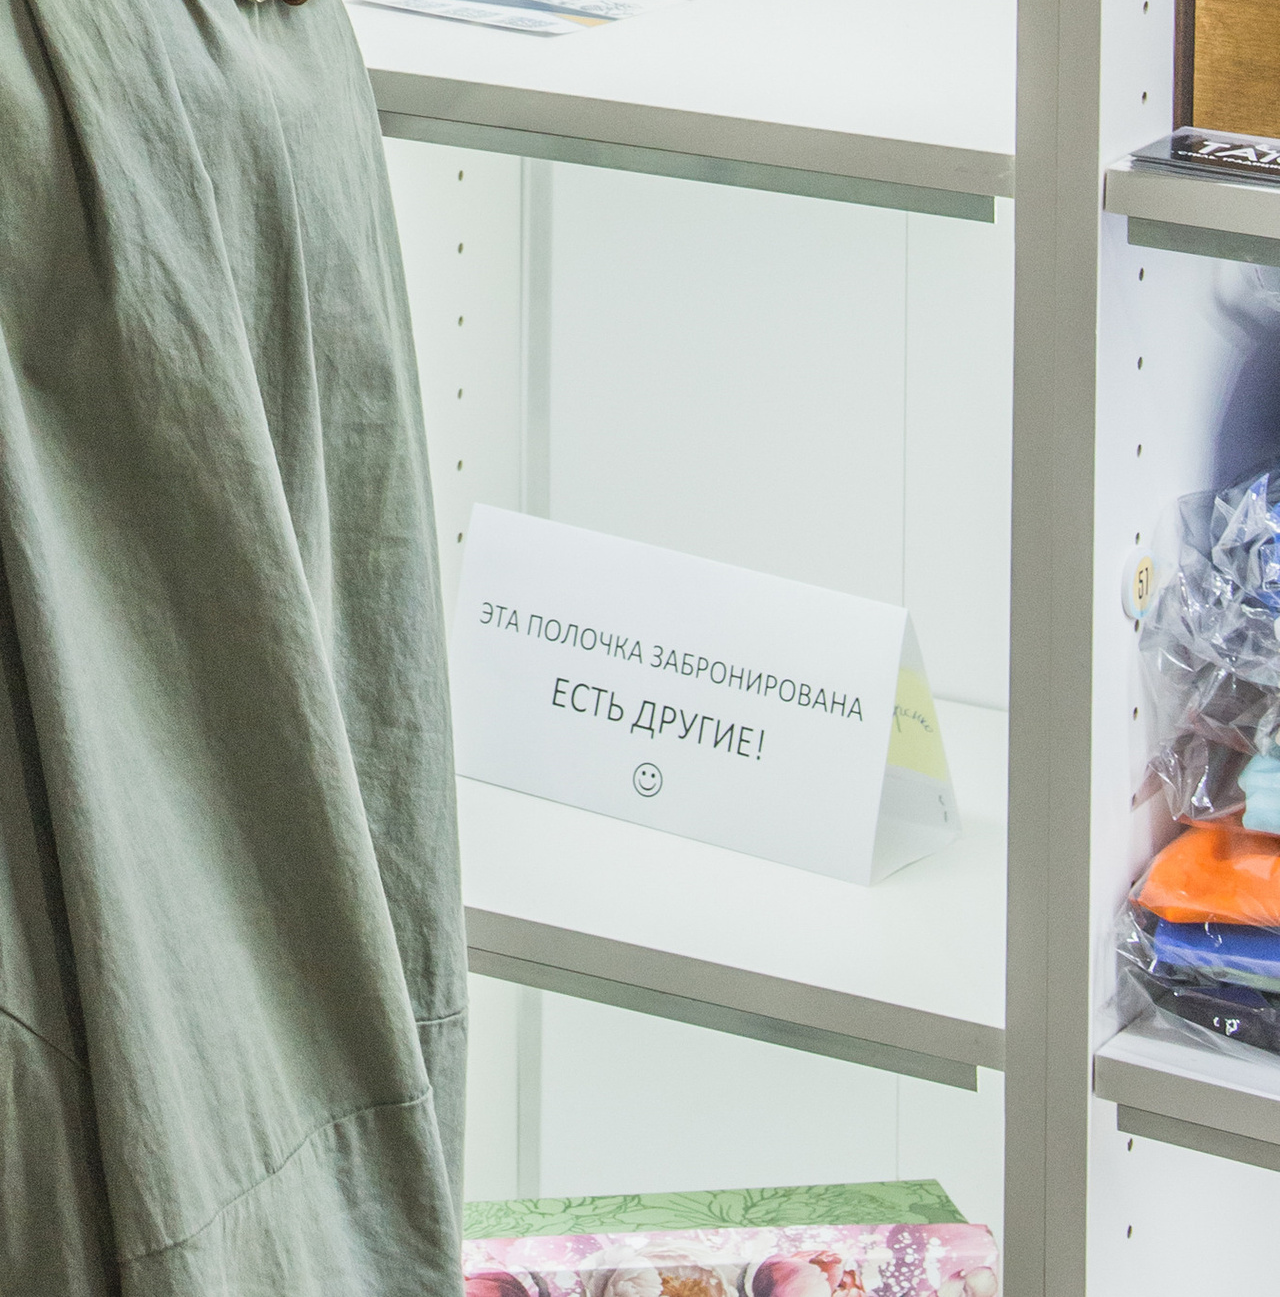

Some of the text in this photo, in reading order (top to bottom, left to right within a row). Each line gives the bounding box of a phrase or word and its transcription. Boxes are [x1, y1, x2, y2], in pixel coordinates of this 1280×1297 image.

[1138, 567, 1149, 600] 51
[479, 601, 520, 633] ЭТА
[526, 614, 643, 664] ПОЛОЧКА
[650, 645, 863, 722] ЗАБРОНИРОВАНА
[552, 677, 766, 761] ЕСТЬ ДРУГИЕ!
